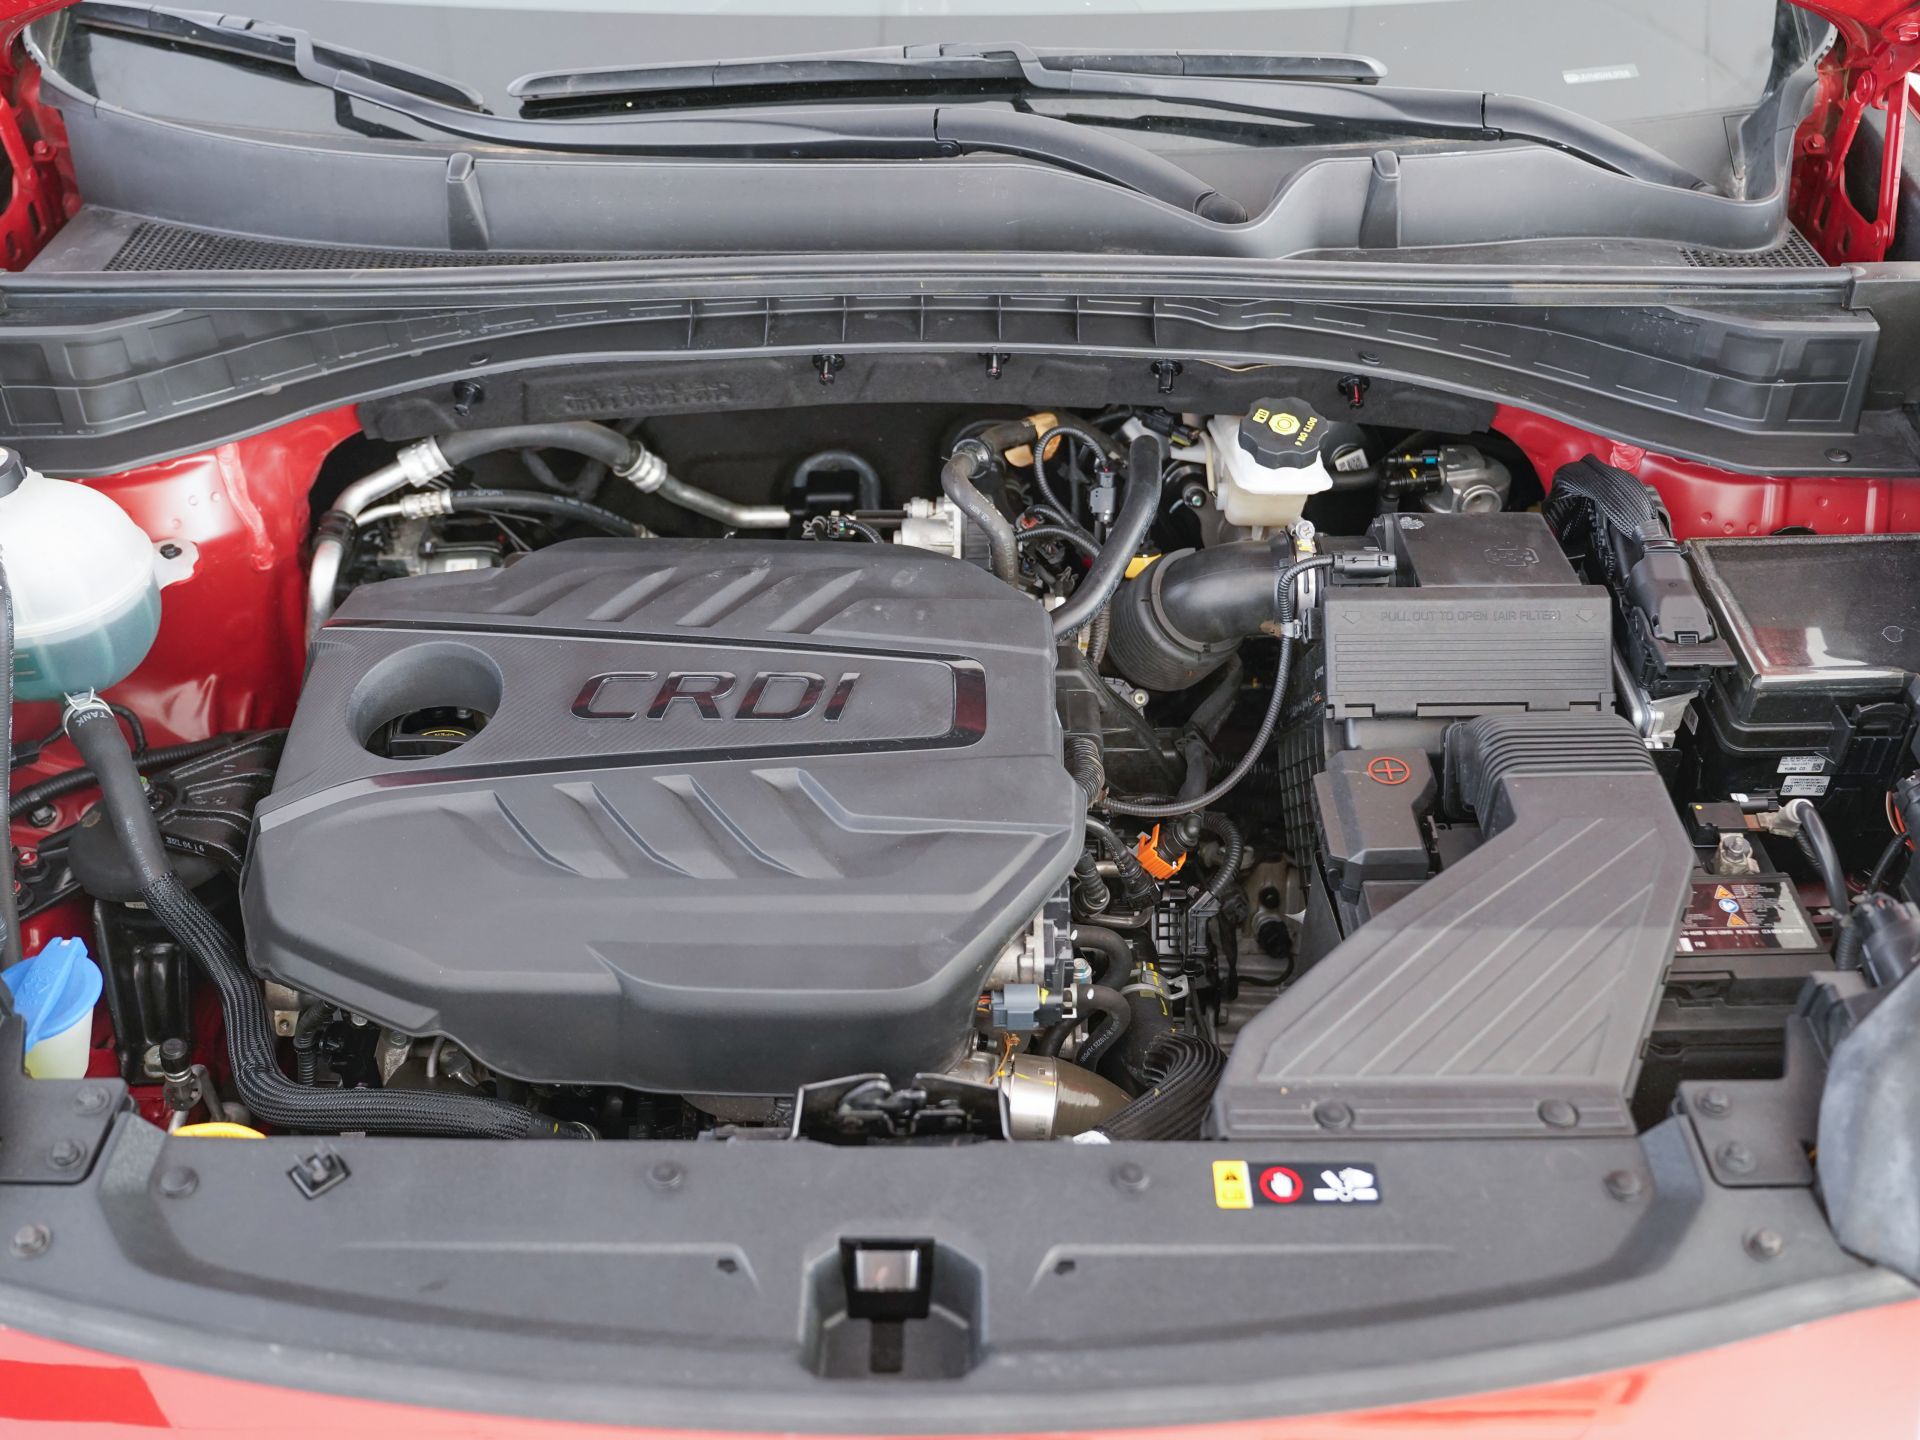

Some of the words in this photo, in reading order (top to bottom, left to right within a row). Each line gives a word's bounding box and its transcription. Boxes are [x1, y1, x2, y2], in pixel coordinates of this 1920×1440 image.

[1303, 416, 1318, 432] DOT3
[1297, 432, 1308, 442] OR
[1381, 611, 1409, 622] PULL
[1412, 611, 1433, 622] OUT
[1440, 611, 1453, 621] TO
[1457, 610, 1488, 622] OPEN
[1493, 610, 1517, 622] (AIR
[1519, 610, 1561, 622] FILTER)
[570, 671, 860, 722] CRDI
[75, 711, 109, 727] TANK
